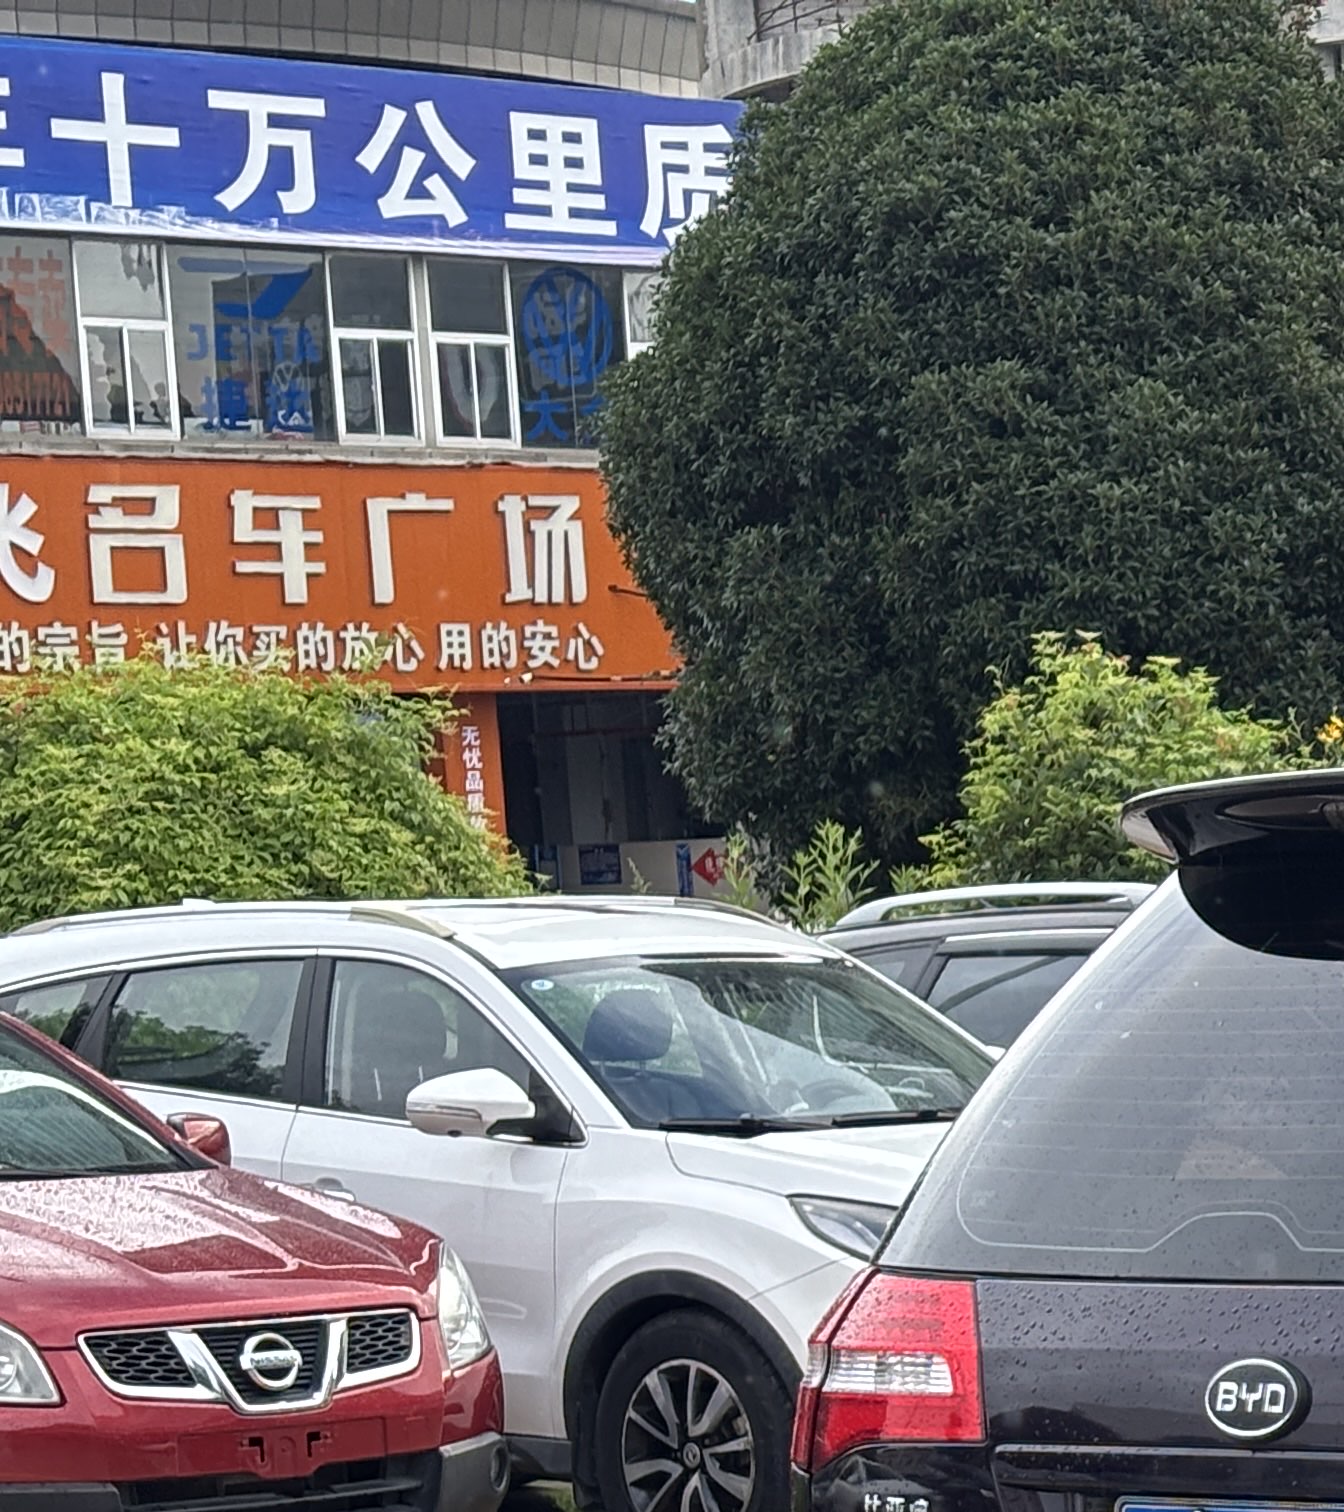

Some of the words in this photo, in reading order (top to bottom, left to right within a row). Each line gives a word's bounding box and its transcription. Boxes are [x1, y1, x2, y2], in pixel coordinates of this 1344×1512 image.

[0, 71, 733, 244] 十万公里质
[437, 618, 605, 672] 用的安心
[1216, 1381, 1286, 1413] BYD
